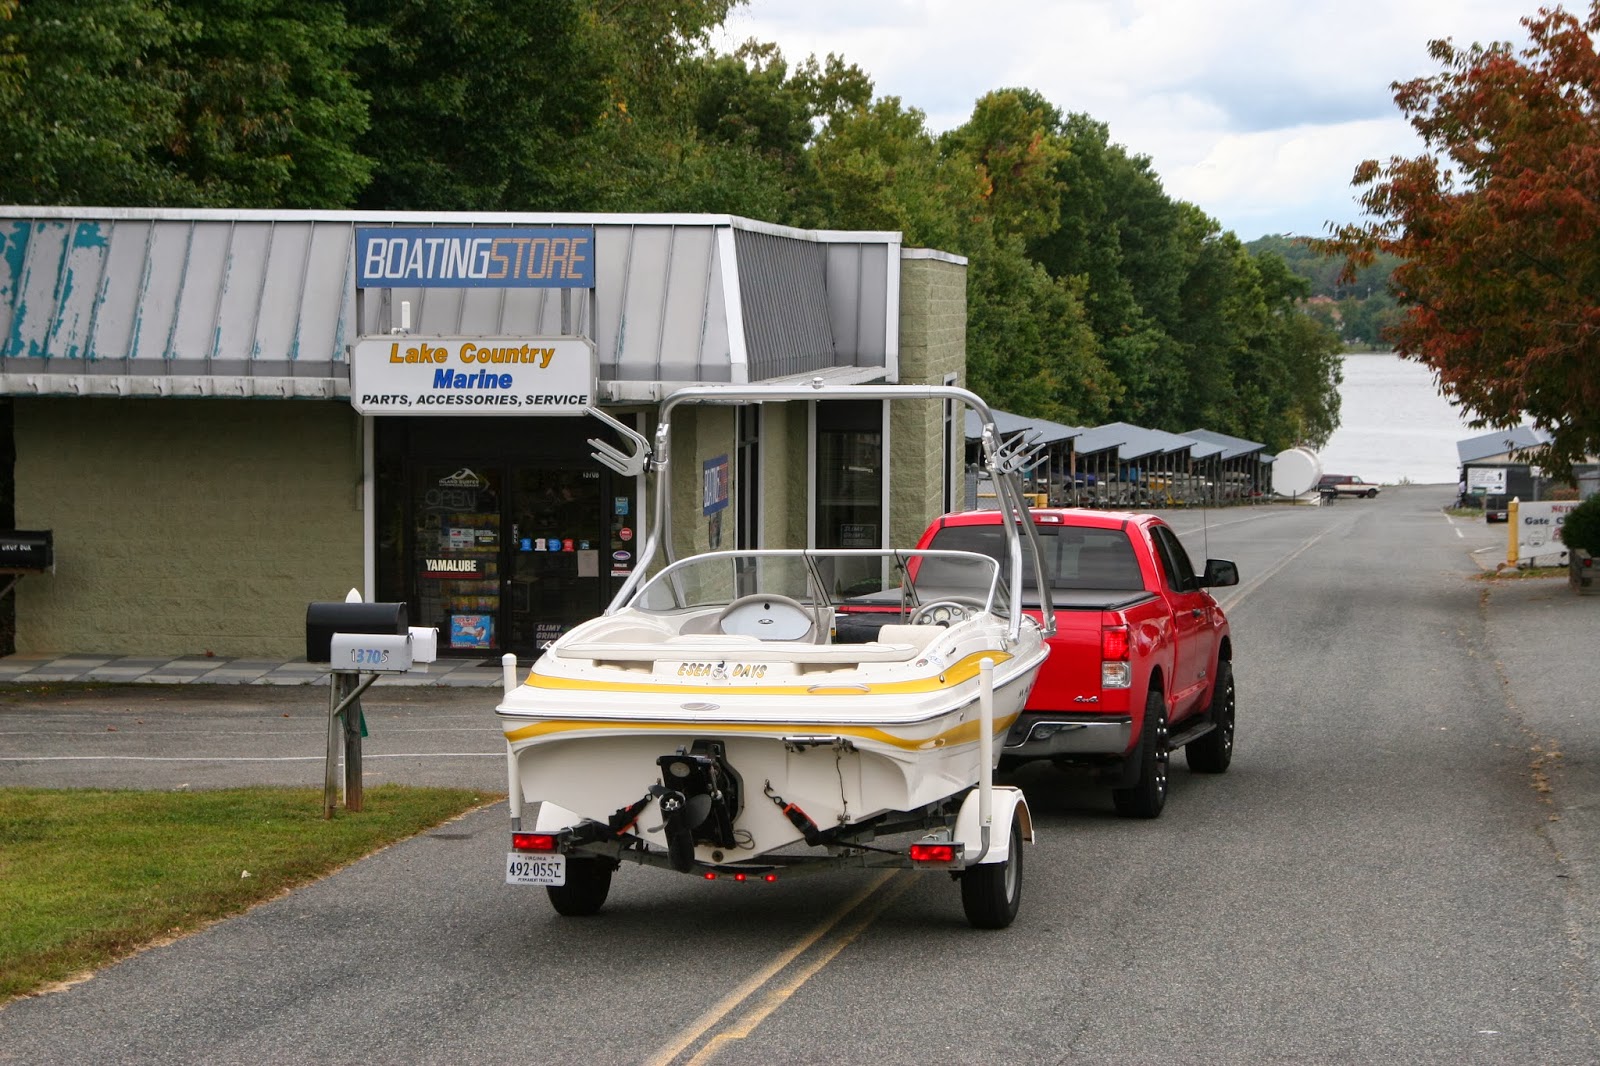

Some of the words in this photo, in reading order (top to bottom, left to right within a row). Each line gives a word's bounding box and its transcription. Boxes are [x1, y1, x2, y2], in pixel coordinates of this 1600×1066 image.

[363, 238, 588, 279] BOATINGSTORE
[389, 343, 448, 364] Lake
[459, 343, 556, 368] Country
[433, 369, 513, 389] Marine
[362, 394, 413, 407] PARTS,
[416, 394, 522, 407] ACCESSORIES,
[525, 394, 588, 406] SERVICE
[425, 489, 476, 507] OPEN
[1525, 517, 1550, 525] Gate
[425, 559, 477, 572] YAMALUBE
[536, 624, 562, 632] SLIMY
[351, 648, 390, 664] 13705
[677, 662, 713, 677] ESEA
[732, 663, 768, 679] DAYS
